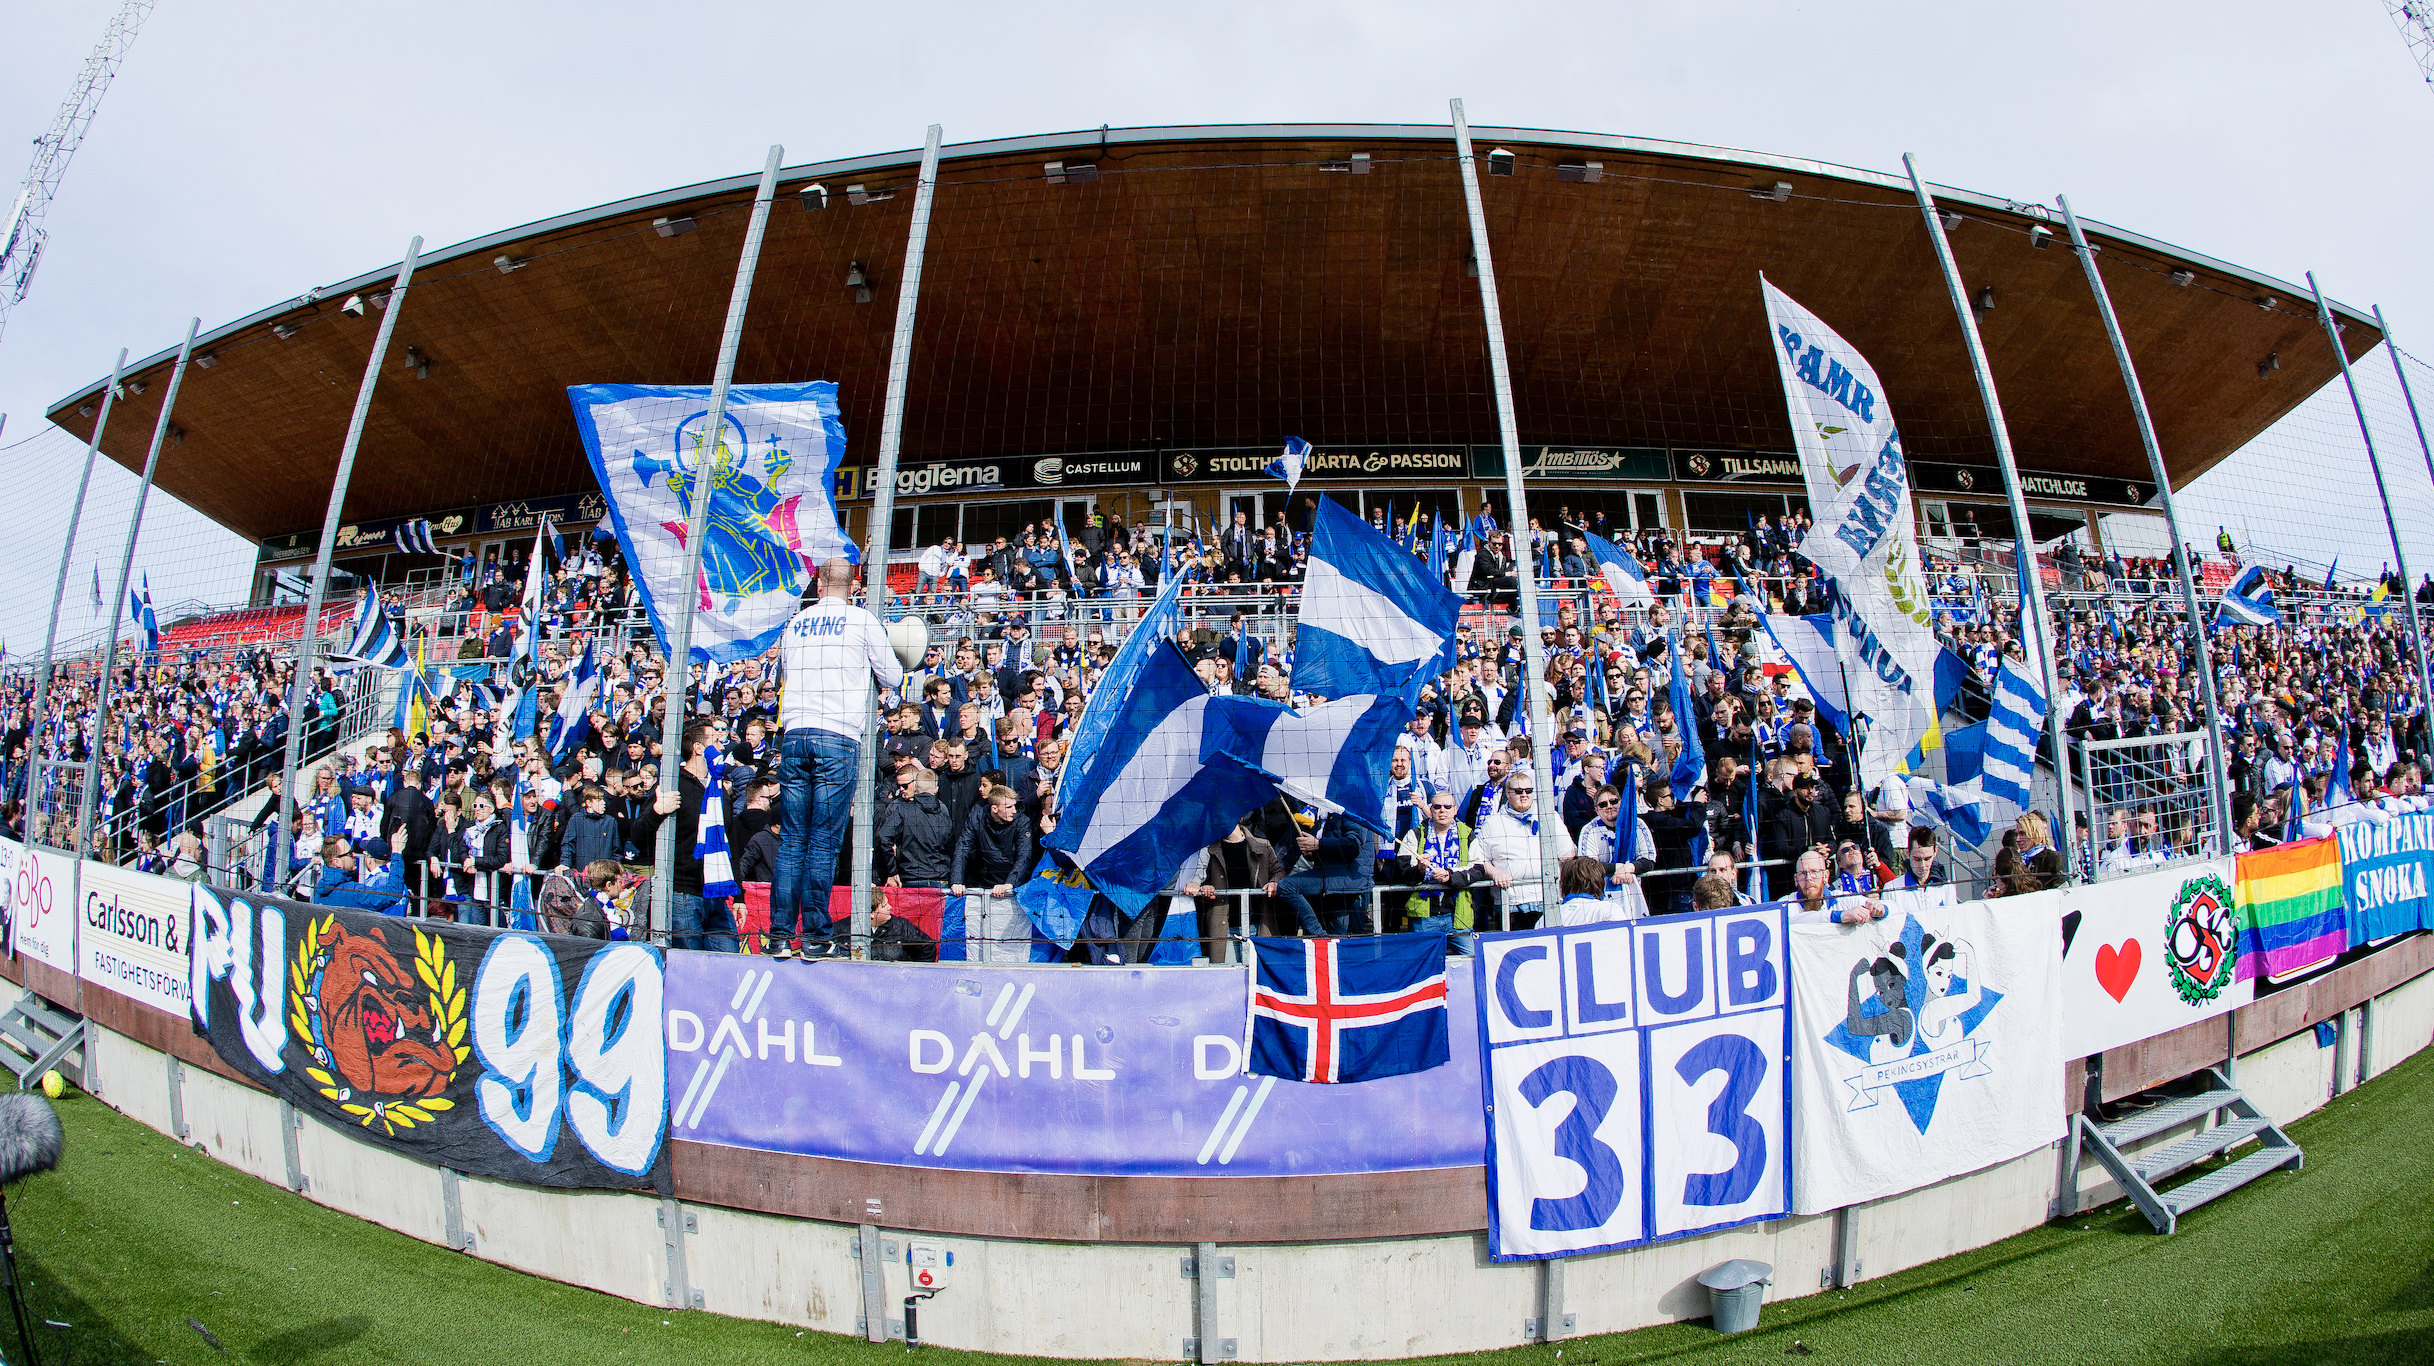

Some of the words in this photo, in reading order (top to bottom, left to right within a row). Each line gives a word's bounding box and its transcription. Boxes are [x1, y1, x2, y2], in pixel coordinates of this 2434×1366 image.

[866, 463, 1000, 494] BggTema
[1066, 461, 1141, 475] CASTELLUM
[1209, 456, 1282, 472] STOLTH
[1363, 452, 1388, 472] &
[1391, 453, 1462, 468] PASSION
[514, 516, 534, 527] KARL
[537, 512, 564, 525] HDIN
[793, 616, 847, 637] PEKING
[2338, 814, 2434, 865] KOMPANI
[2356, 861, 2428, 913] SNOKA
[87, 891, 159, 947] Carlsson
[165, 914, 179, 953] &
[1495, 918, 1777, 1028] CLUB
[471, 933, 669, 1177] 99
[1877, 1050, 1959, 1081] PEKINGSYSTRAR
[1517, 1034, 1767, 1231] 33
